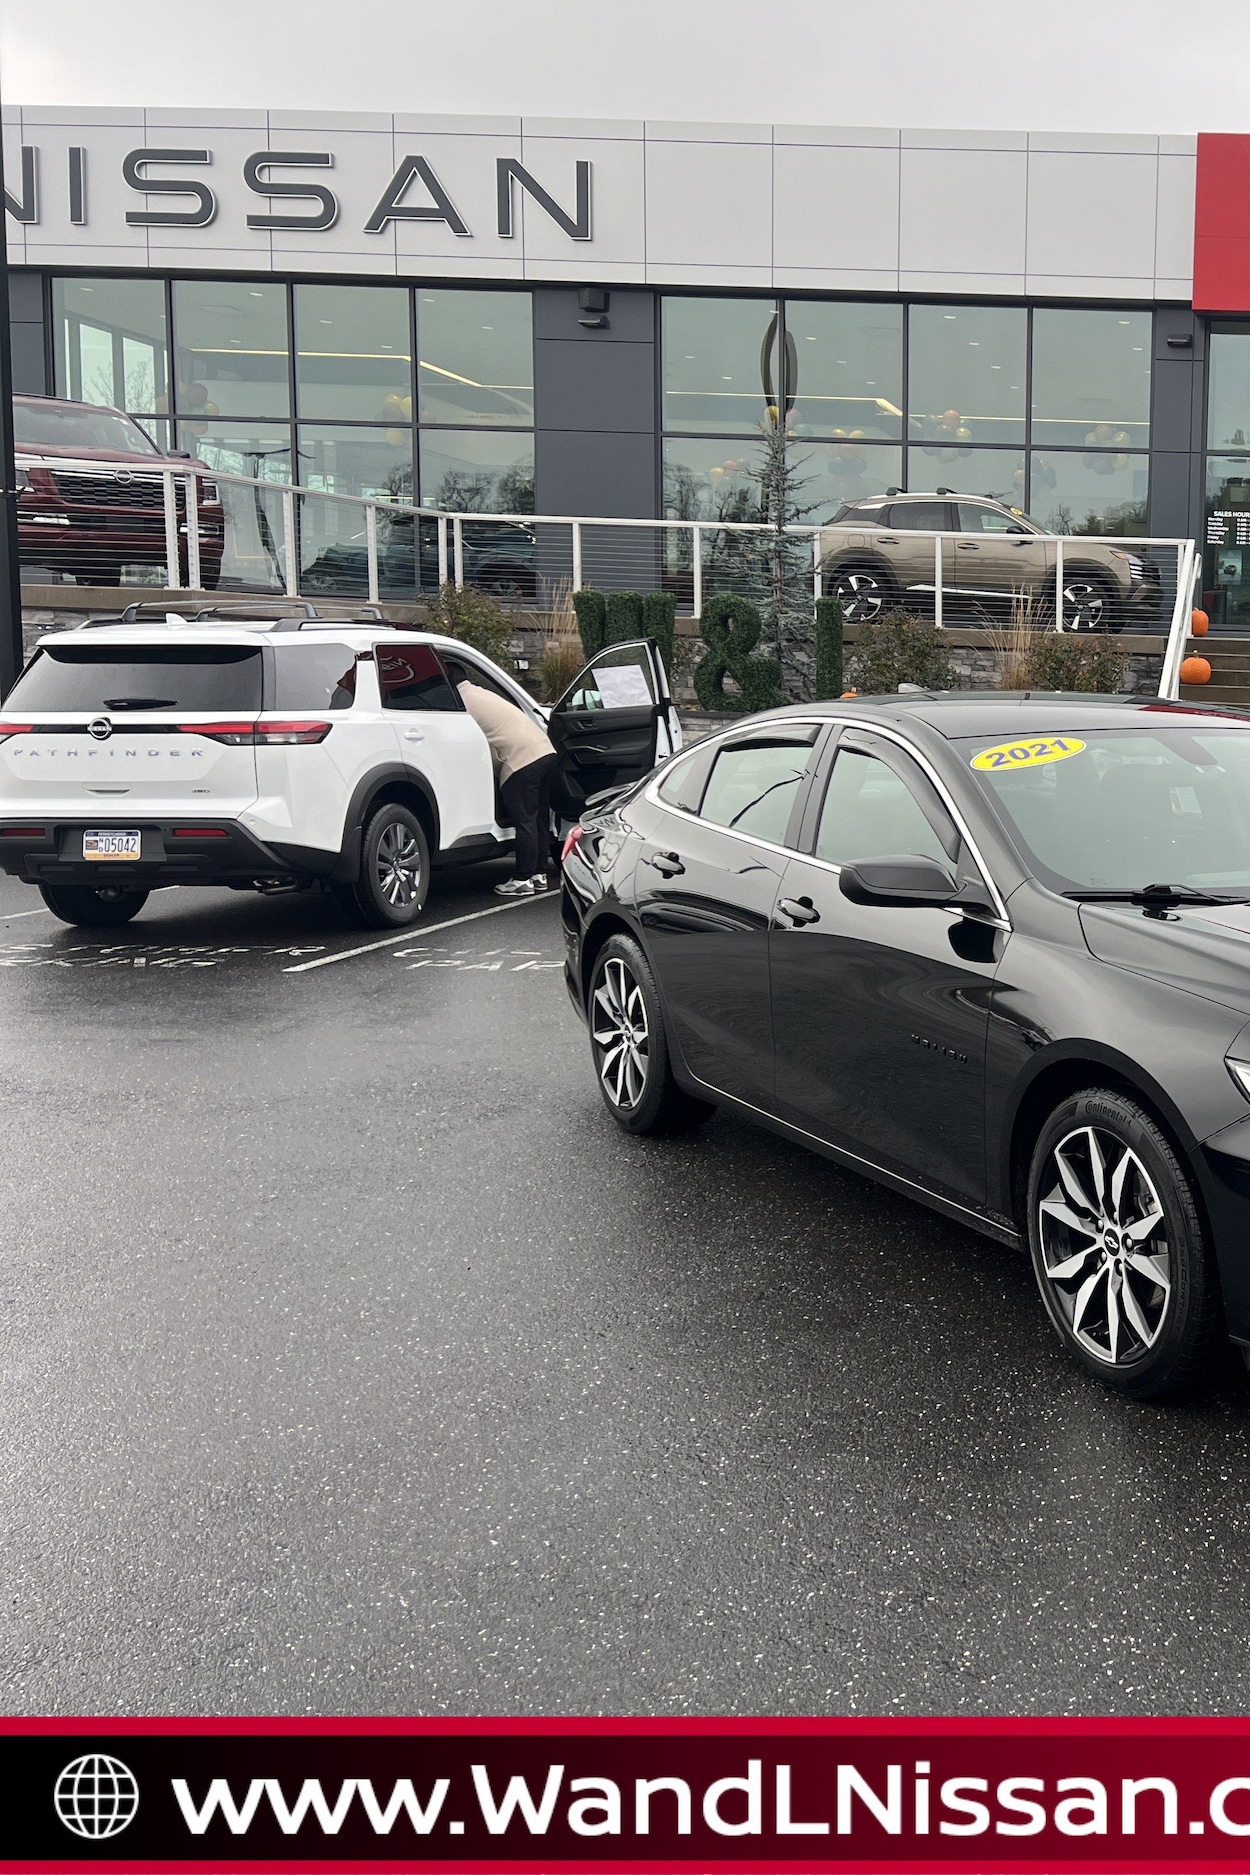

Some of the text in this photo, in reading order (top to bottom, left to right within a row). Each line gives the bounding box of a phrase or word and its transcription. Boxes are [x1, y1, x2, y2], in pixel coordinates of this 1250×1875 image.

[986, 739, 1069, 768] 2021
[105, 838, 136, 852] 05042
[1086, 1100, 1128, 1123] Continental
